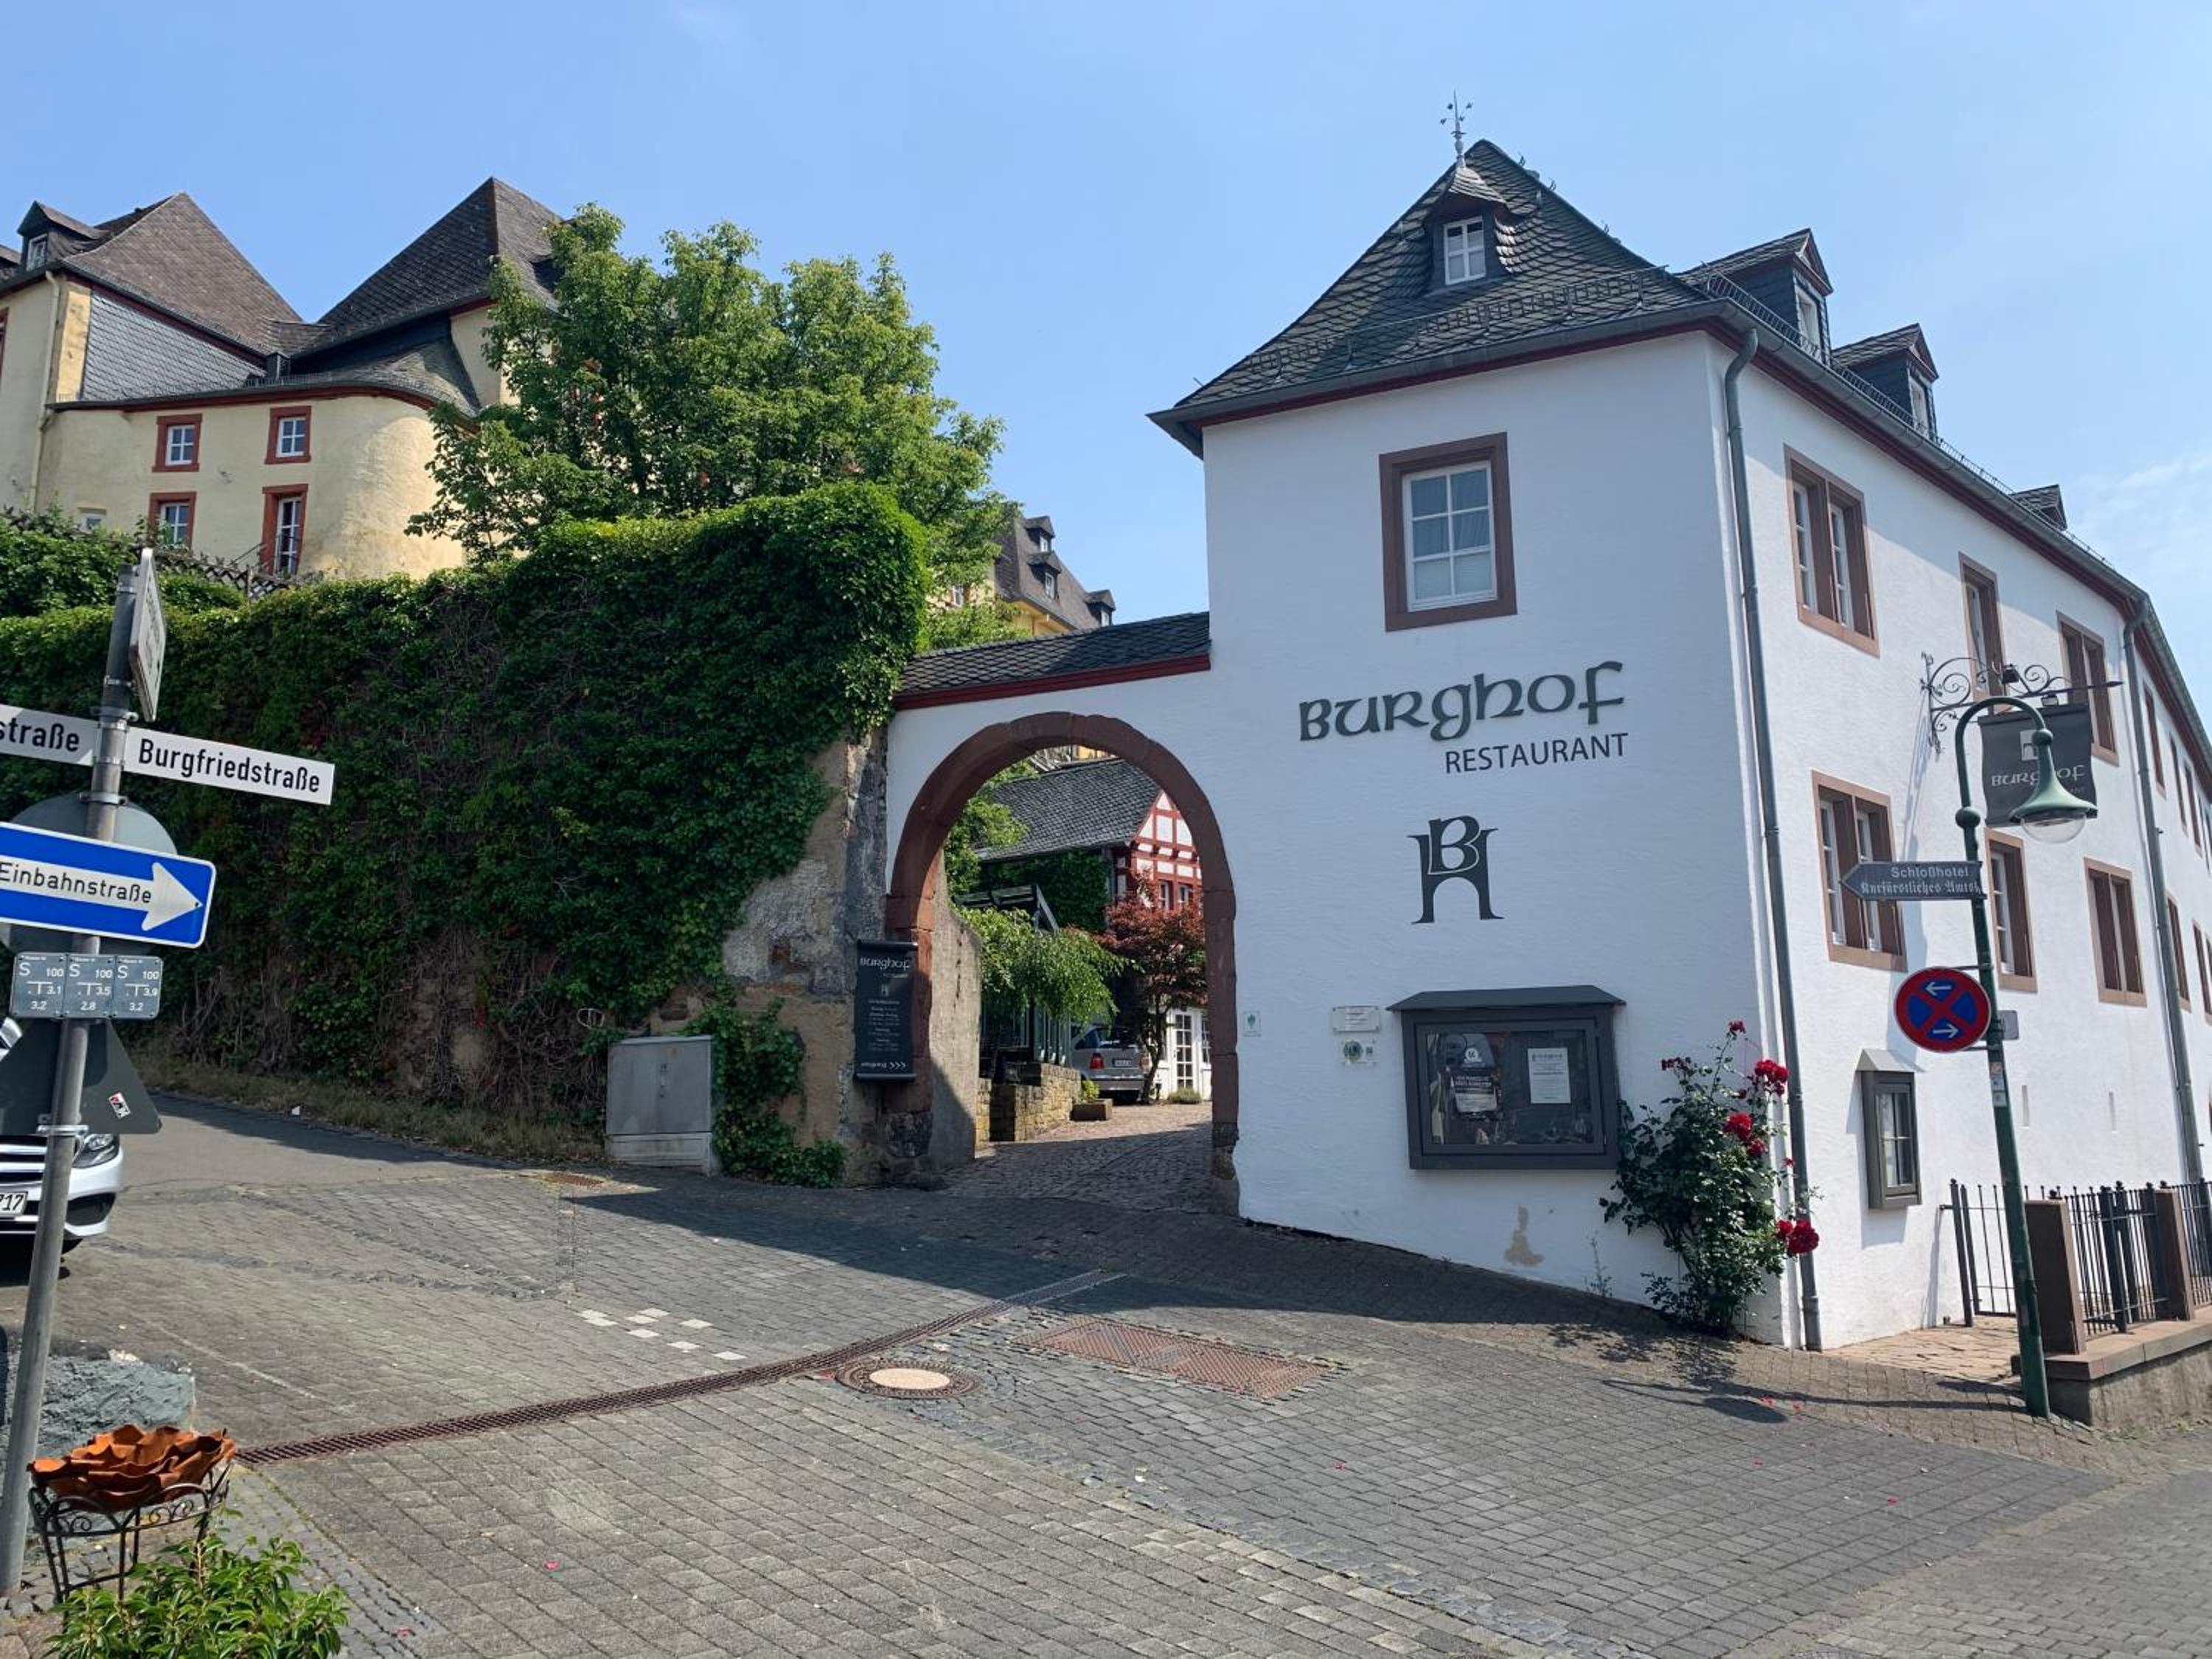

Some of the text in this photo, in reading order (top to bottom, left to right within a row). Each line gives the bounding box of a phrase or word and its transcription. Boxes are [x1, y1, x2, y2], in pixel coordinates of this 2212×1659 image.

[1445, 732, 1629, 773] RESTAURANT
[139, 738, 320, 793] Burgfriedstraße
[1891, 866, 1969, 879] Schloßhotel
[0, 861, 152, 904] Einbahnstraße
[18, 962, 64, 977] S 100
[69, 964, 113, 978] S 100
[117, 965, 159, 979] S 100
